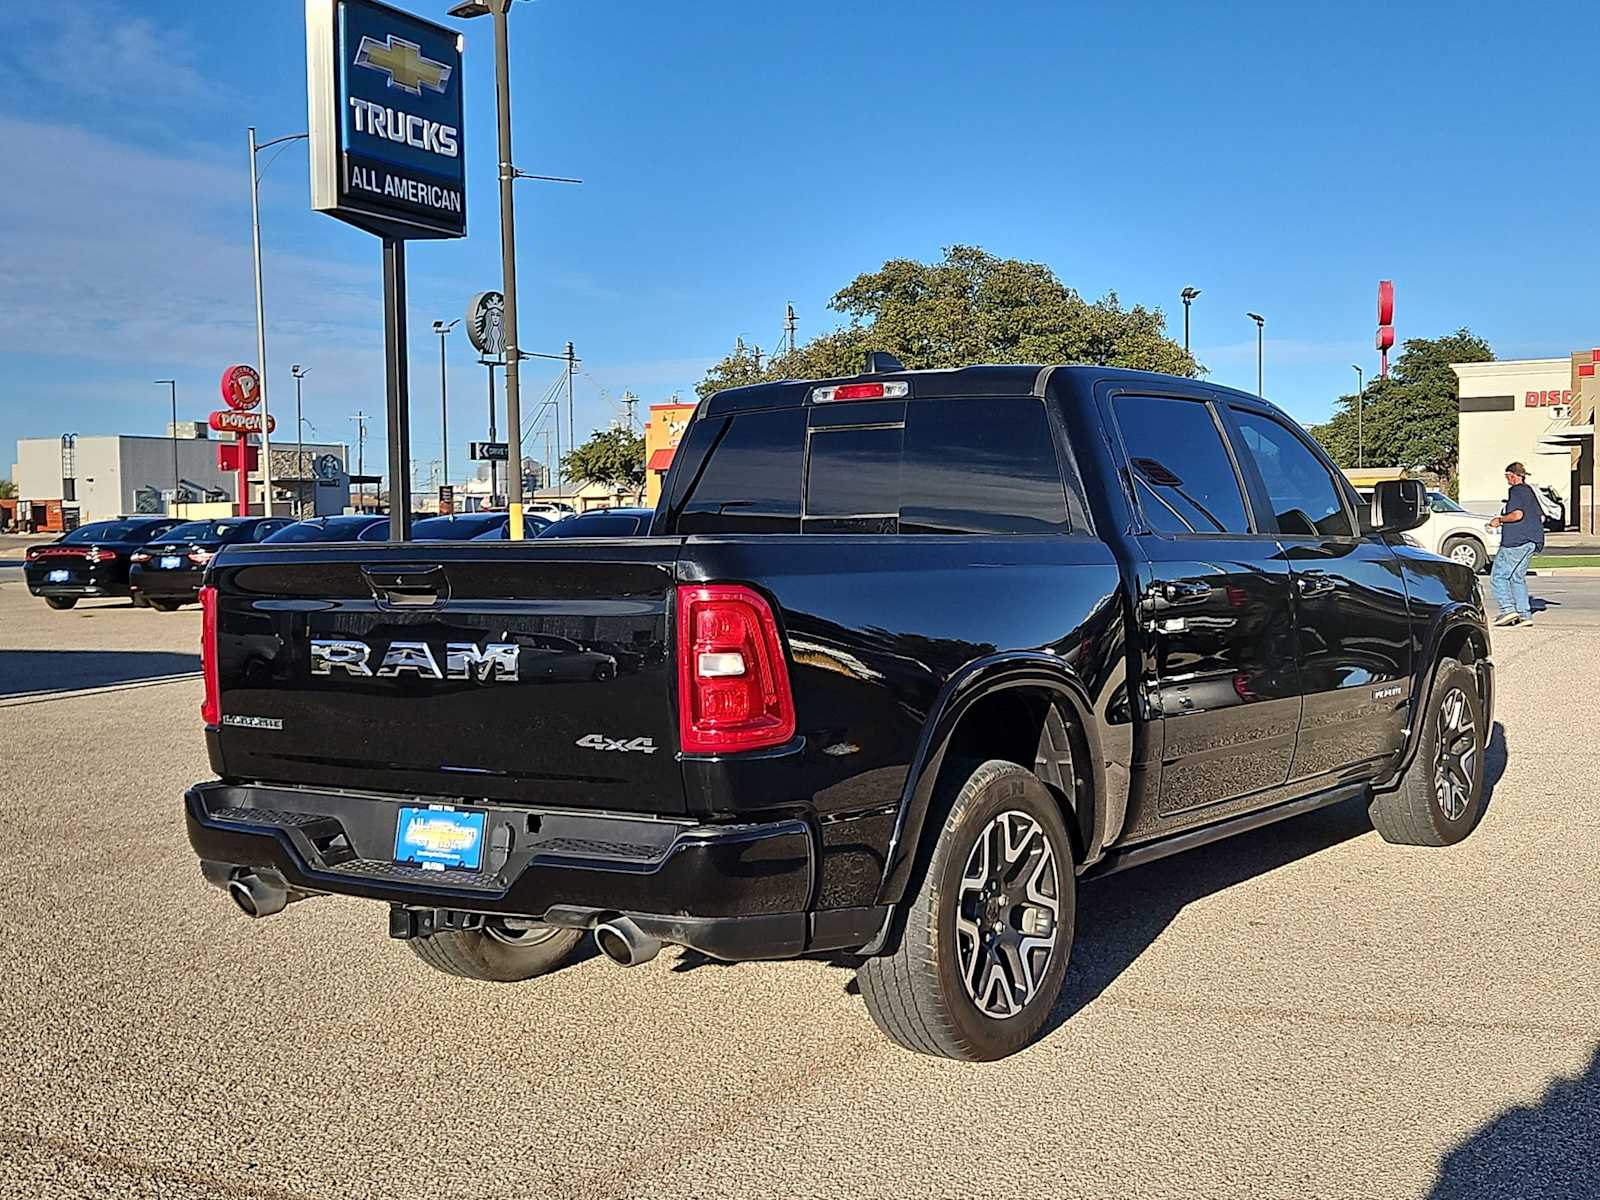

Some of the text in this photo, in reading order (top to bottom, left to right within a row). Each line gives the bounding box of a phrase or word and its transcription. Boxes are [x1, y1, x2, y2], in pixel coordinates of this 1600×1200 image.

[350, 96, 458, 157] TRUCKS
[352, 166, 461, 213] ALL AMERICAN
[310, 639, 520, 683] RAM
